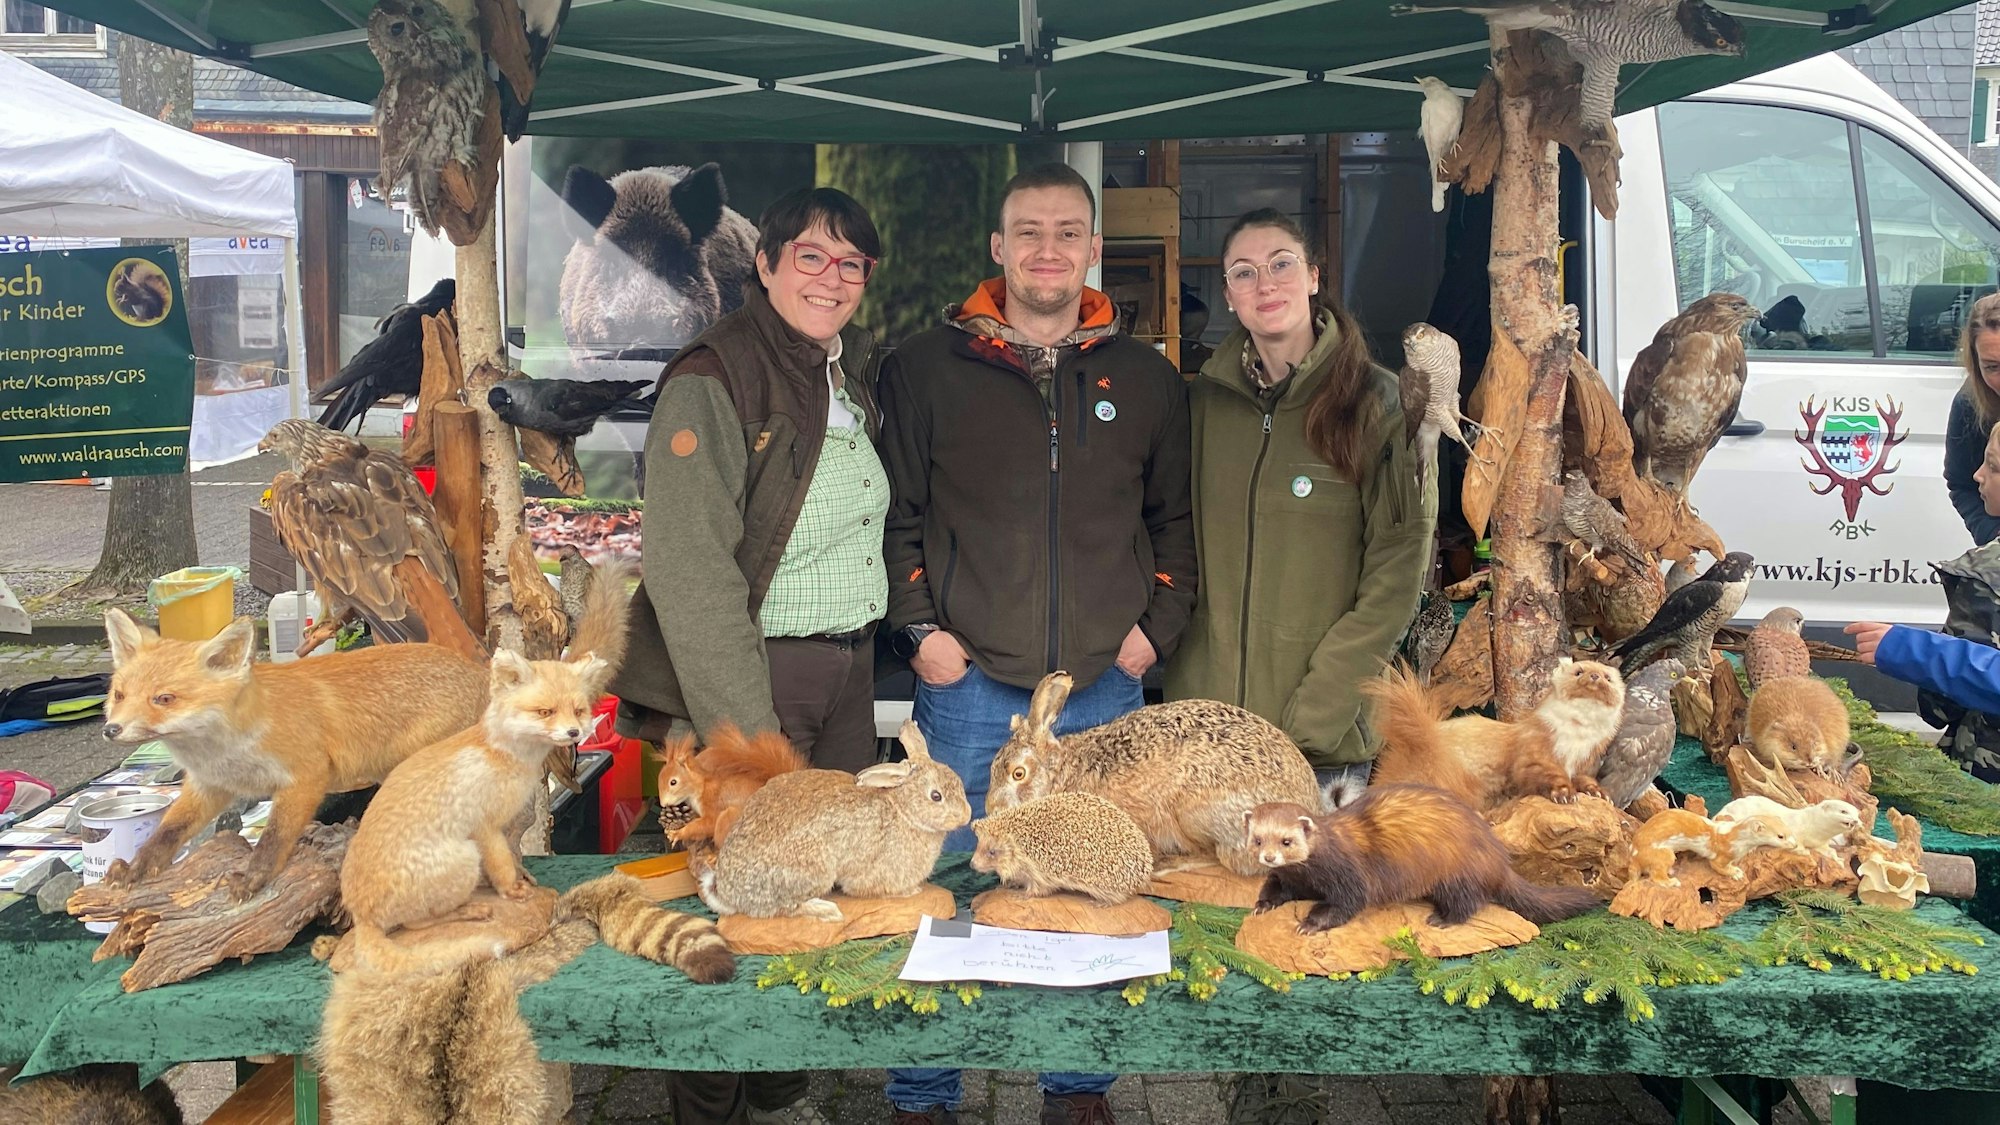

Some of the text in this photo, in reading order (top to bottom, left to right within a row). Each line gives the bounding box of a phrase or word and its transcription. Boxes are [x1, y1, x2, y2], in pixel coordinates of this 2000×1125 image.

[228, 236, 269, 250] avea
[0, 300, 86, 321] r Kinder
[0, 402, 111, 421] etteraktionen
[1833, 397, 1870, 412] KJS
[19, 442, 183, 464] www.waldrausch.com
[1829, 518, 1877, 540] RBK
[94, 856, 107, 866] für
